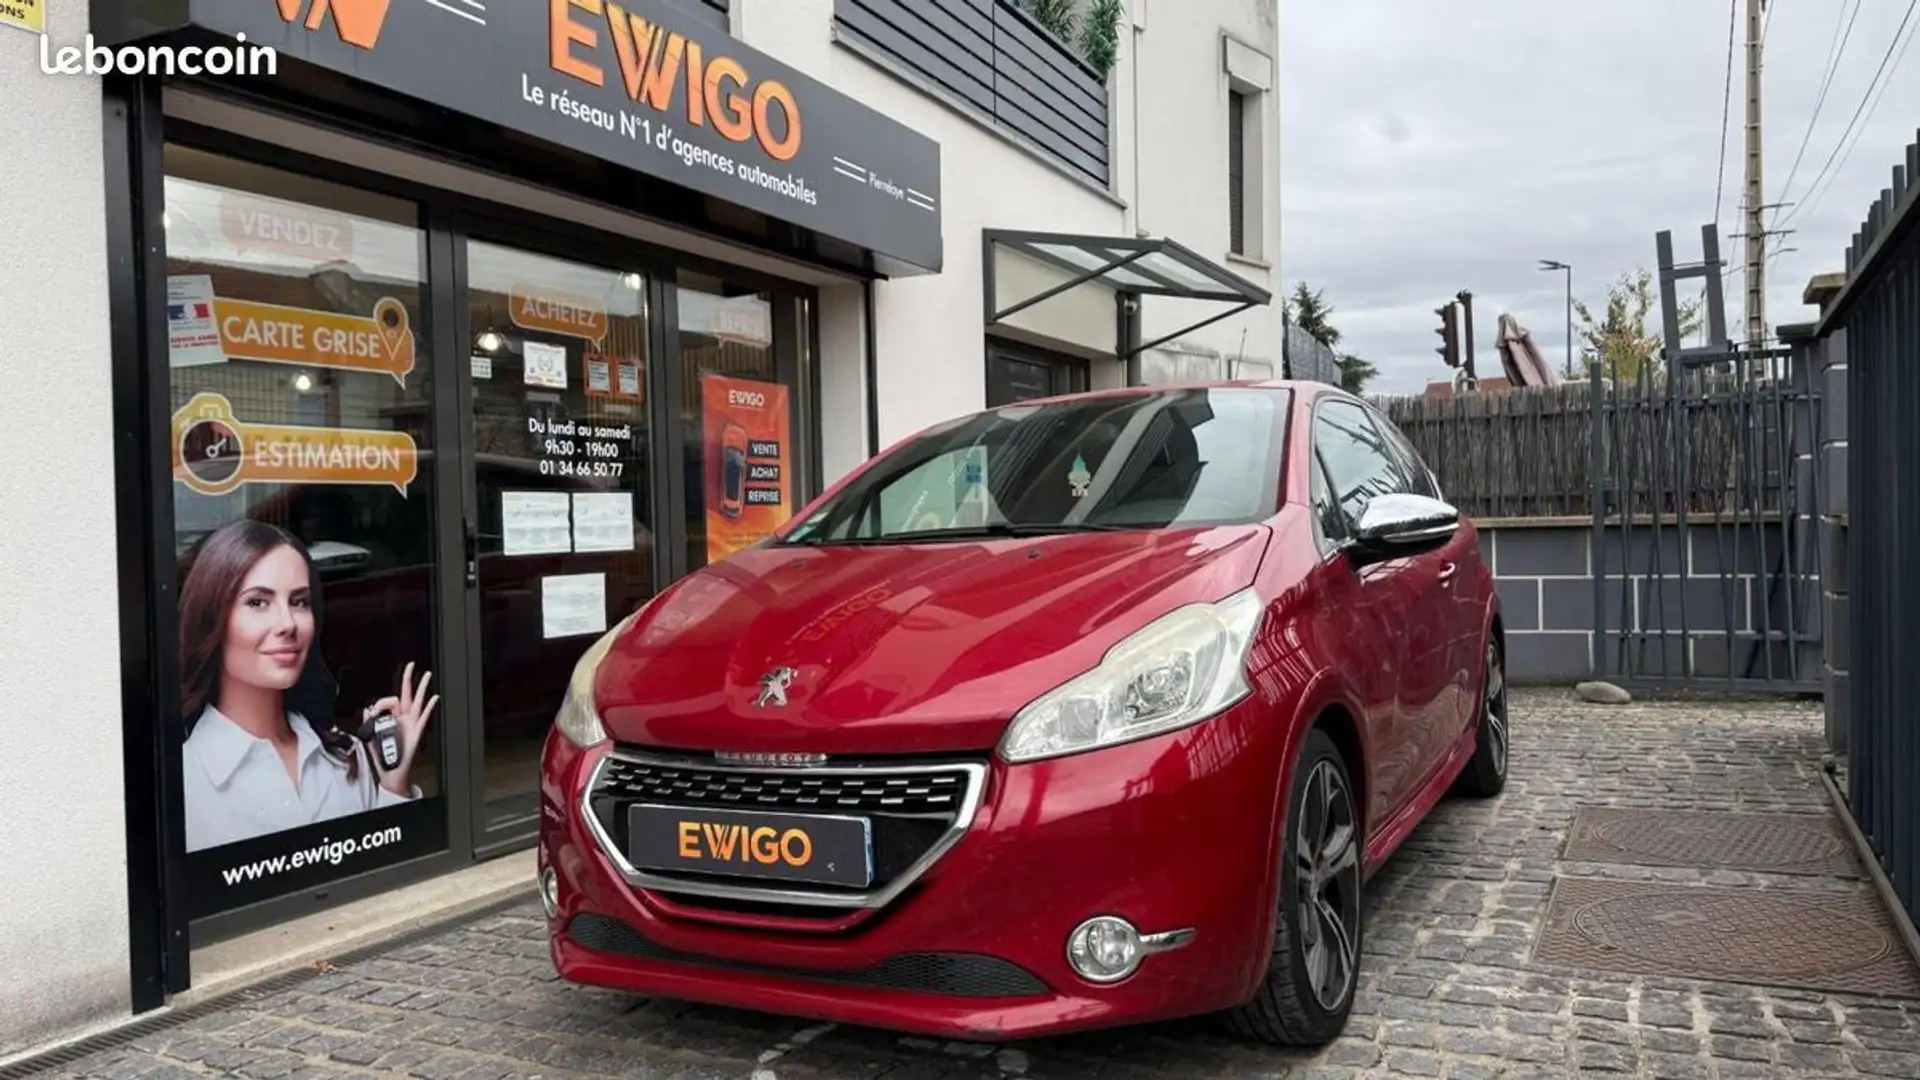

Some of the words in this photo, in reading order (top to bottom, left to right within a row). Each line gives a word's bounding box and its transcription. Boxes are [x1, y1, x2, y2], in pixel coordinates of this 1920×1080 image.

[548, 0, 803, 161] EWIGO
[521, 73, 544, 105] Le
[550, 90, 614, 131] réseau
[619, 110, 651, 144] N°1
[655, 124, 734, 175] d'agences
[738, 164, 818, 206] automobiles
[238, 208, 342, 252] VENDEZ
[521, 294, 598, 328] ACHETEZ
[223, 316, 305, 350] CARTE
[313, 326, 381, 358] GRISE
[728, 389, 765, 407] EWIGO
[528, 418, 545, 435] Du
[548, 418, 575, 436] lundi
[578, 424, 592, 437] au
[594, 423, 631, 439] samedi
[254, 441, 400, 471] ESTIMATION
[545, 440, 574, 456] 9h30
[585, 442, 618, 458] 19h00
[751, 443, 777, 456] VENTE
[540, 460, 554, 475] 01
[558, 461, 573, 475] 34
[576, 461, 590, 476] 66
[593, 462, 608, 476] 50
[610, 462, 623, 476] 77
[750, 466, 778, 479] ACHAT
[222, 824, 402, 886] www.ewigo.com
[678, 820, 813, 866] EWIGO
